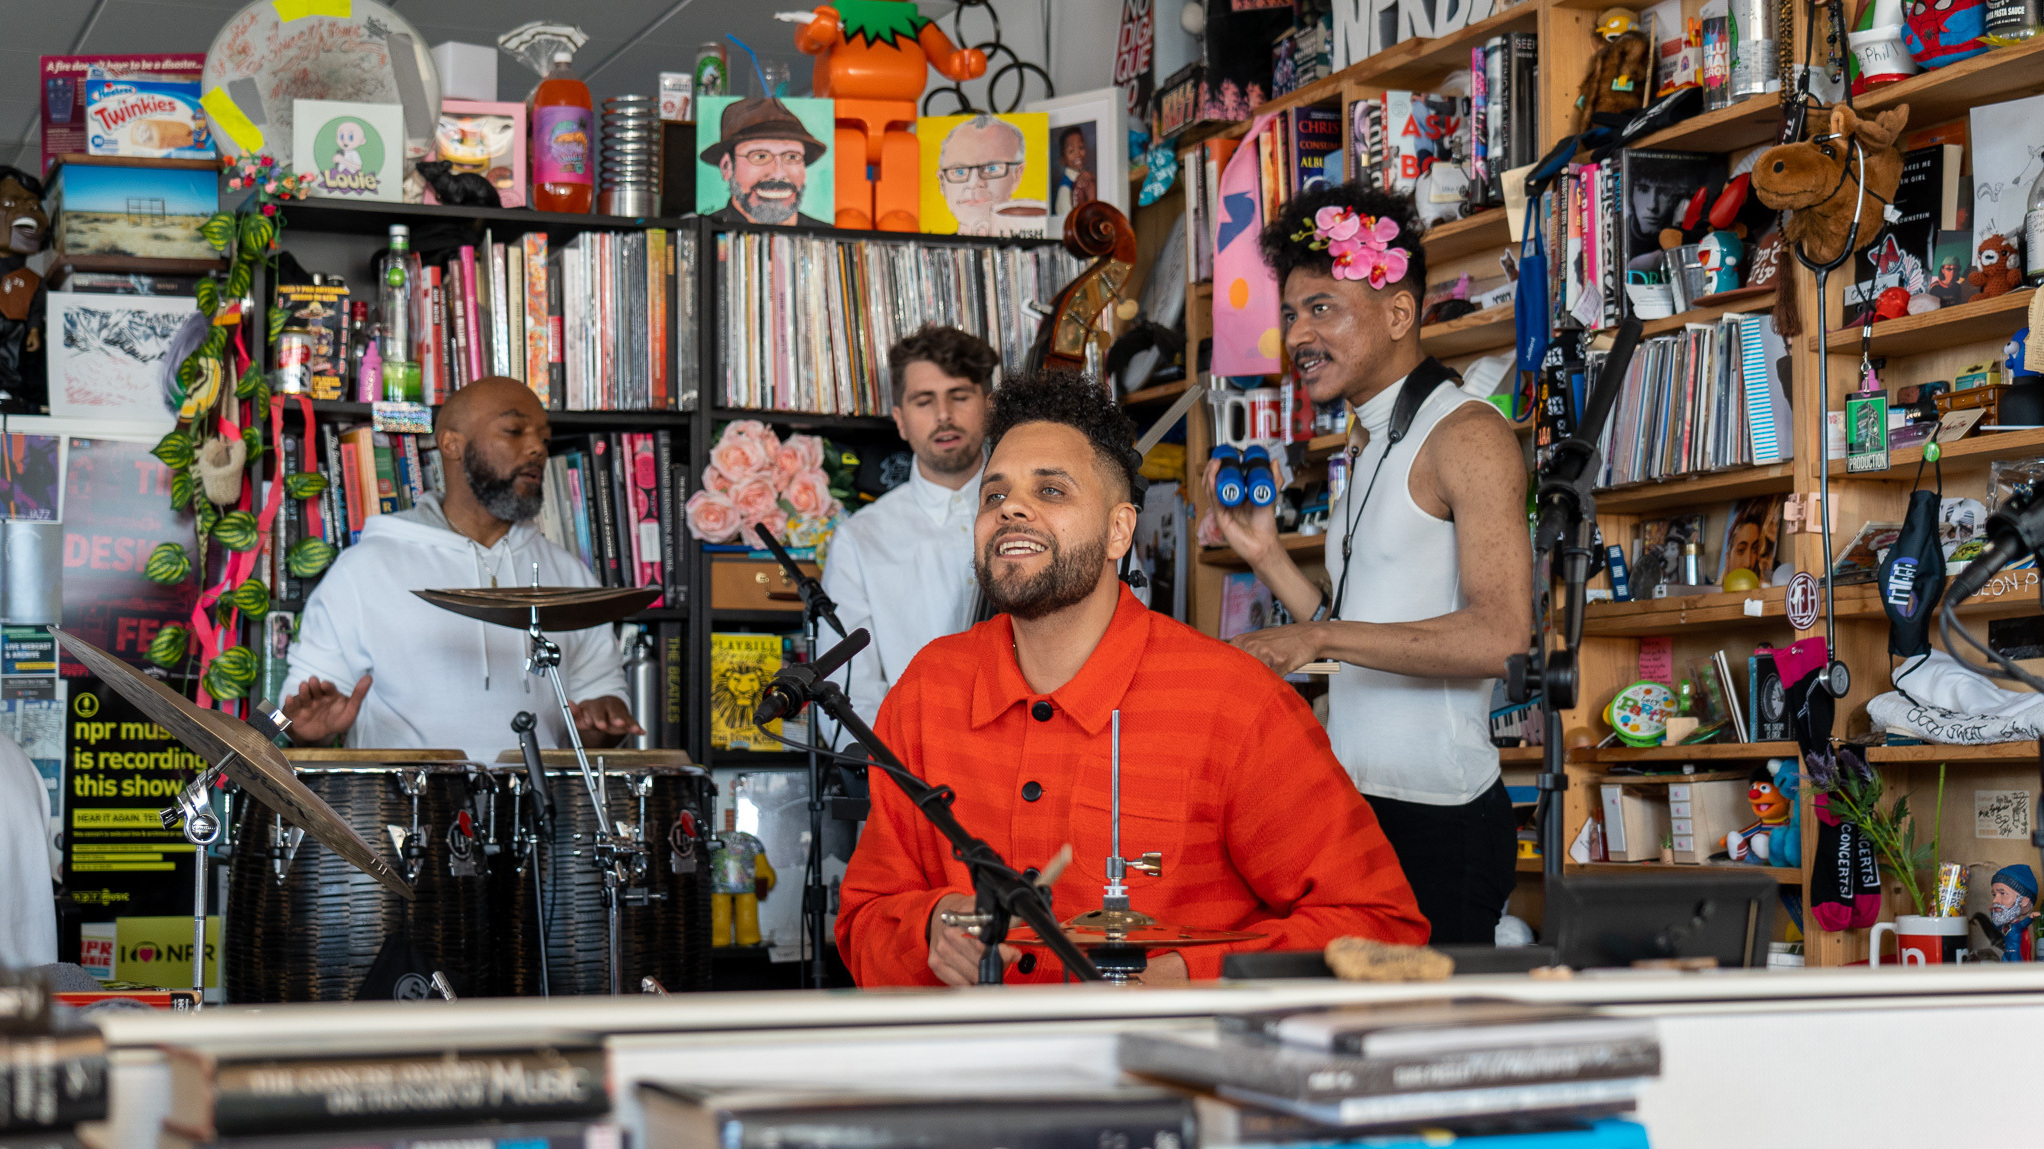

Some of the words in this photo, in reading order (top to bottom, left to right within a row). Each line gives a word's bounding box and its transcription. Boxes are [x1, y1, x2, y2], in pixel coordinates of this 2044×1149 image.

[1993, 9, 2007, 19] PASTA
[2008, 6, 2025, 16] SAUCE
[47, 62, 54, 71] A
[54, 61, 71, 74] fire
[130, 61, 138, 70] to
[140, 60, 152, 70] be
[94, 96, 177, 131] Twinkies
[1298, 121, 1341, 135] CHRIS
[1903, 163, 1920, 172] AKES
[1922, 160, 1931, 168] ME
[324, 169, 378, 190] Louie
[1911, 174, 1926, 183] GIRL
[1849, 452, 1886, 470] PRODUCTION
[382, 499, 392, 513] R
[29, 509, 51, 520] JAZZ
[5, 642, 18, 650] LIVE
[20, 642, 52, 651] WEBCAST
[667, 637, 680, 662] THE
[711, 638, 777, 652] PLAYBILL
[12, 651, 40, 659] ARCHIVE
[667, 665, 680, 724] BEATLES
[74, 721, 117, 745] npr
[120, 722, 178, 740] mus
[74, 747, 94, 770] is
[98, 747, 208, 775] recording
[74, 774, 118, 797] this
[121, 774, 182, 797] show
[77, 814, 101, 822] HEAR
[102, 814, 111, 822] IT
[143, 814, 160, 822] TEL
[1837, 824, 1852, 895] CONCERTS
[1857, 832, 1875, 884] NCERTS
[490, 1058, 592, 1105] Music
